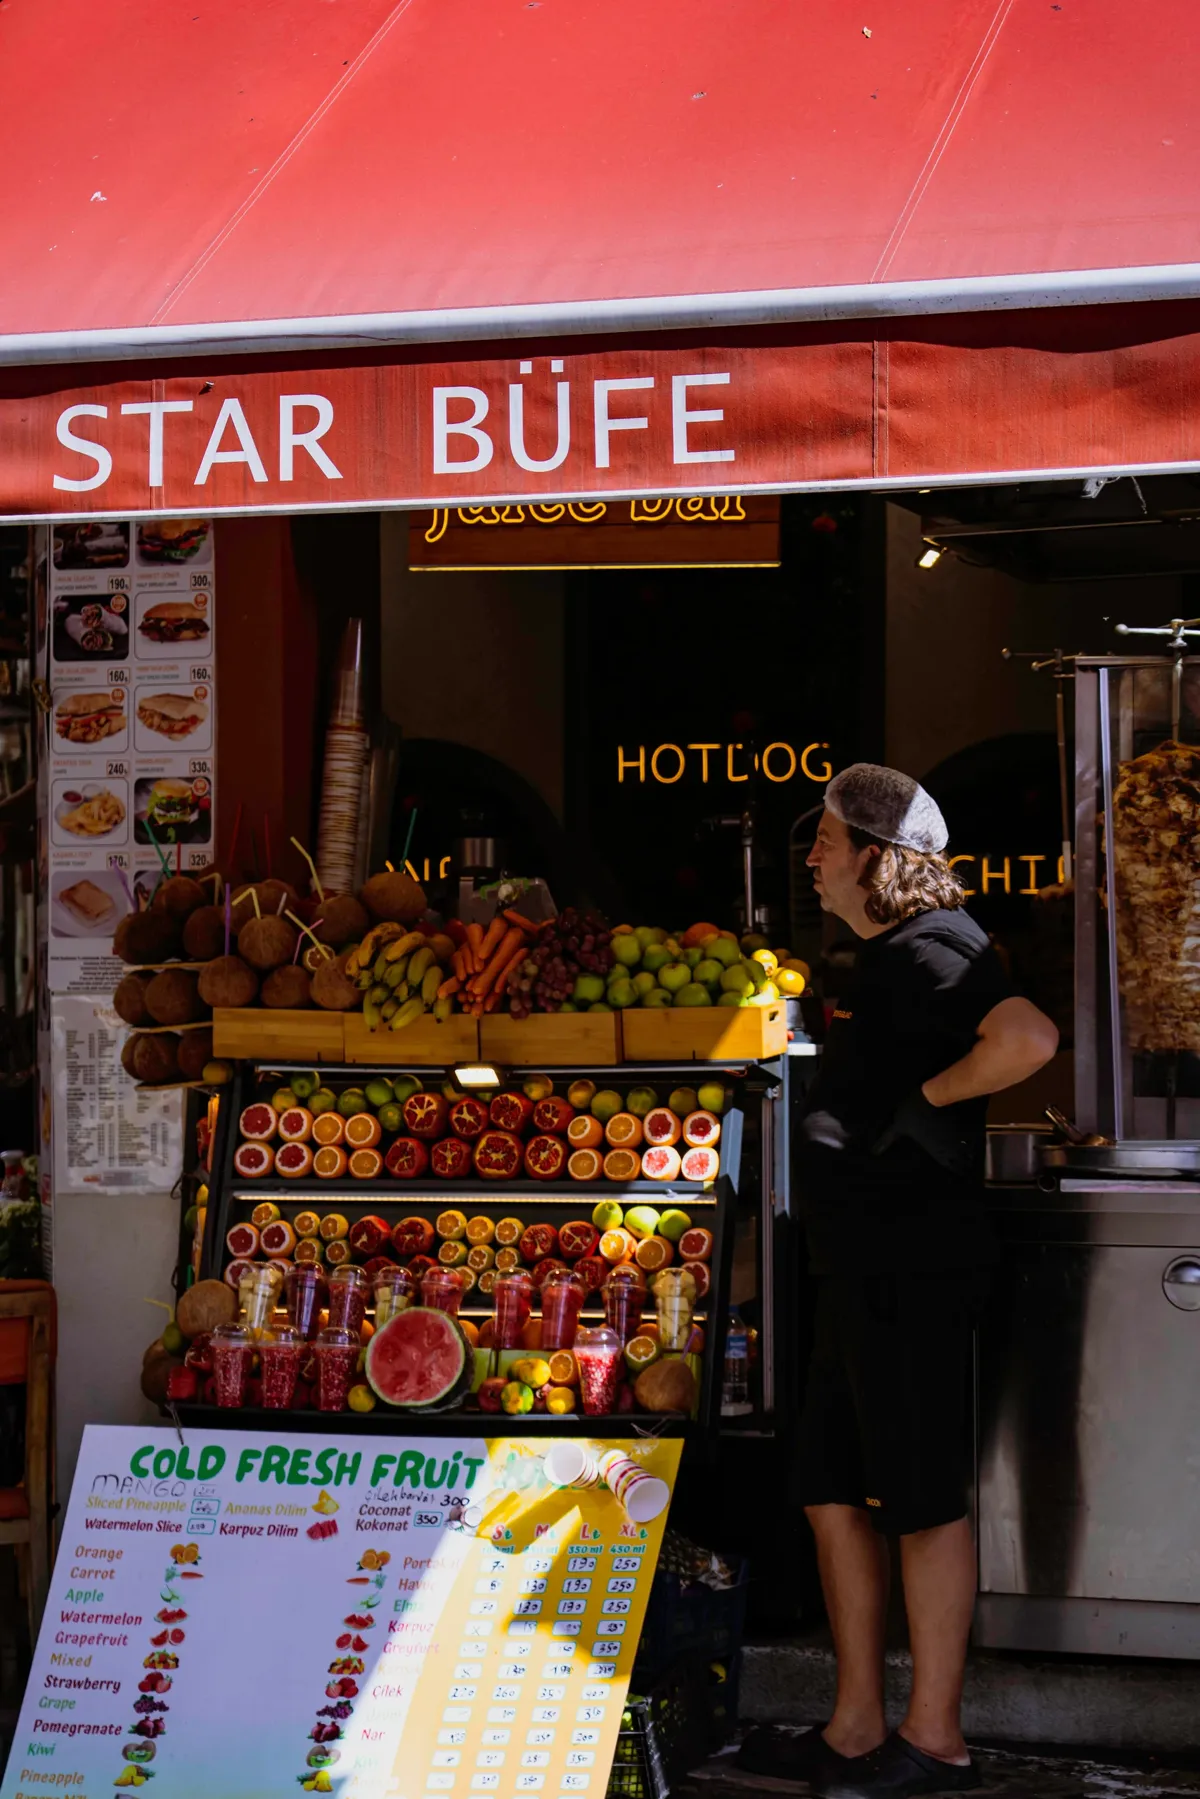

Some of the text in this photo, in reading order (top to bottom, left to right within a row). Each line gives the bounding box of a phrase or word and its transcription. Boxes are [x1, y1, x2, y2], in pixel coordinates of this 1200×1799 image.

[52, 359, 736, 491] STAR BÜFE
[617, 741, 833, 784] HOTDOG
[130, 1444, 227, 1481] COLD
[235, 1445, 362, 1487] FRESH
[86, 1495, 122, 1510] Sliced
[125, 1497, 187, 1514] Pineapple
[440, 1494, 470, 1507] 300
[224, 1502, 272, 1516] Ananas
[274, 1503, 308, 1517] Dilim
[358, 1503, 439, 1525] Coconat 350
[84, 1517, 183, 1533] Watermelon Slice
[219, 1521, 299, 1539] Karpuz Dilim
[356, 1518, 409, 1532] Kokonat
[581, 1524, 590, 1540] L
[620, 1524, 637, 1538] XL
[74, 1545, 124, 1561] Orange
[569, 1545, 588, 1555] 350
[589, 1544, 603, 1555] ml
[610, 1545, 631, 1555] 450
[632, 1544, 647, 1555] ml
[572, 1558, 595, 1571] 190
[615, 1559, 638, 1570] 250
[70, 1566, 116, 1580] Carrot
[525, 1579, 632, 1593] 130 190 250
[64, 1587, 104, 1604] Apple
[517, 1601, 538, 1613] 130
[607, 1601, 628, 1613] 250
[60, 1610, 142, 1627] Watermelon
[387, 1619, 434, 1637] Karpuz
[54, 1631, 129, 1648] Grapefruit
[382, 1641, 441, 1658] Greyfurt
[50, 1652, 93, 1668] Mixed
[44, 1674, 121, 1694] Strawberry
[371, 1684, 404, 1700] Çilek
[38, 1695, 76, 1712] Grape
[33, 1718, 122, 1737] Pomegranate
[361, 1727, 386, 1742] Nar
[27, 1742, 56, 1756] Kiwi
[20, 1768, 85, 1787] Pineapple
